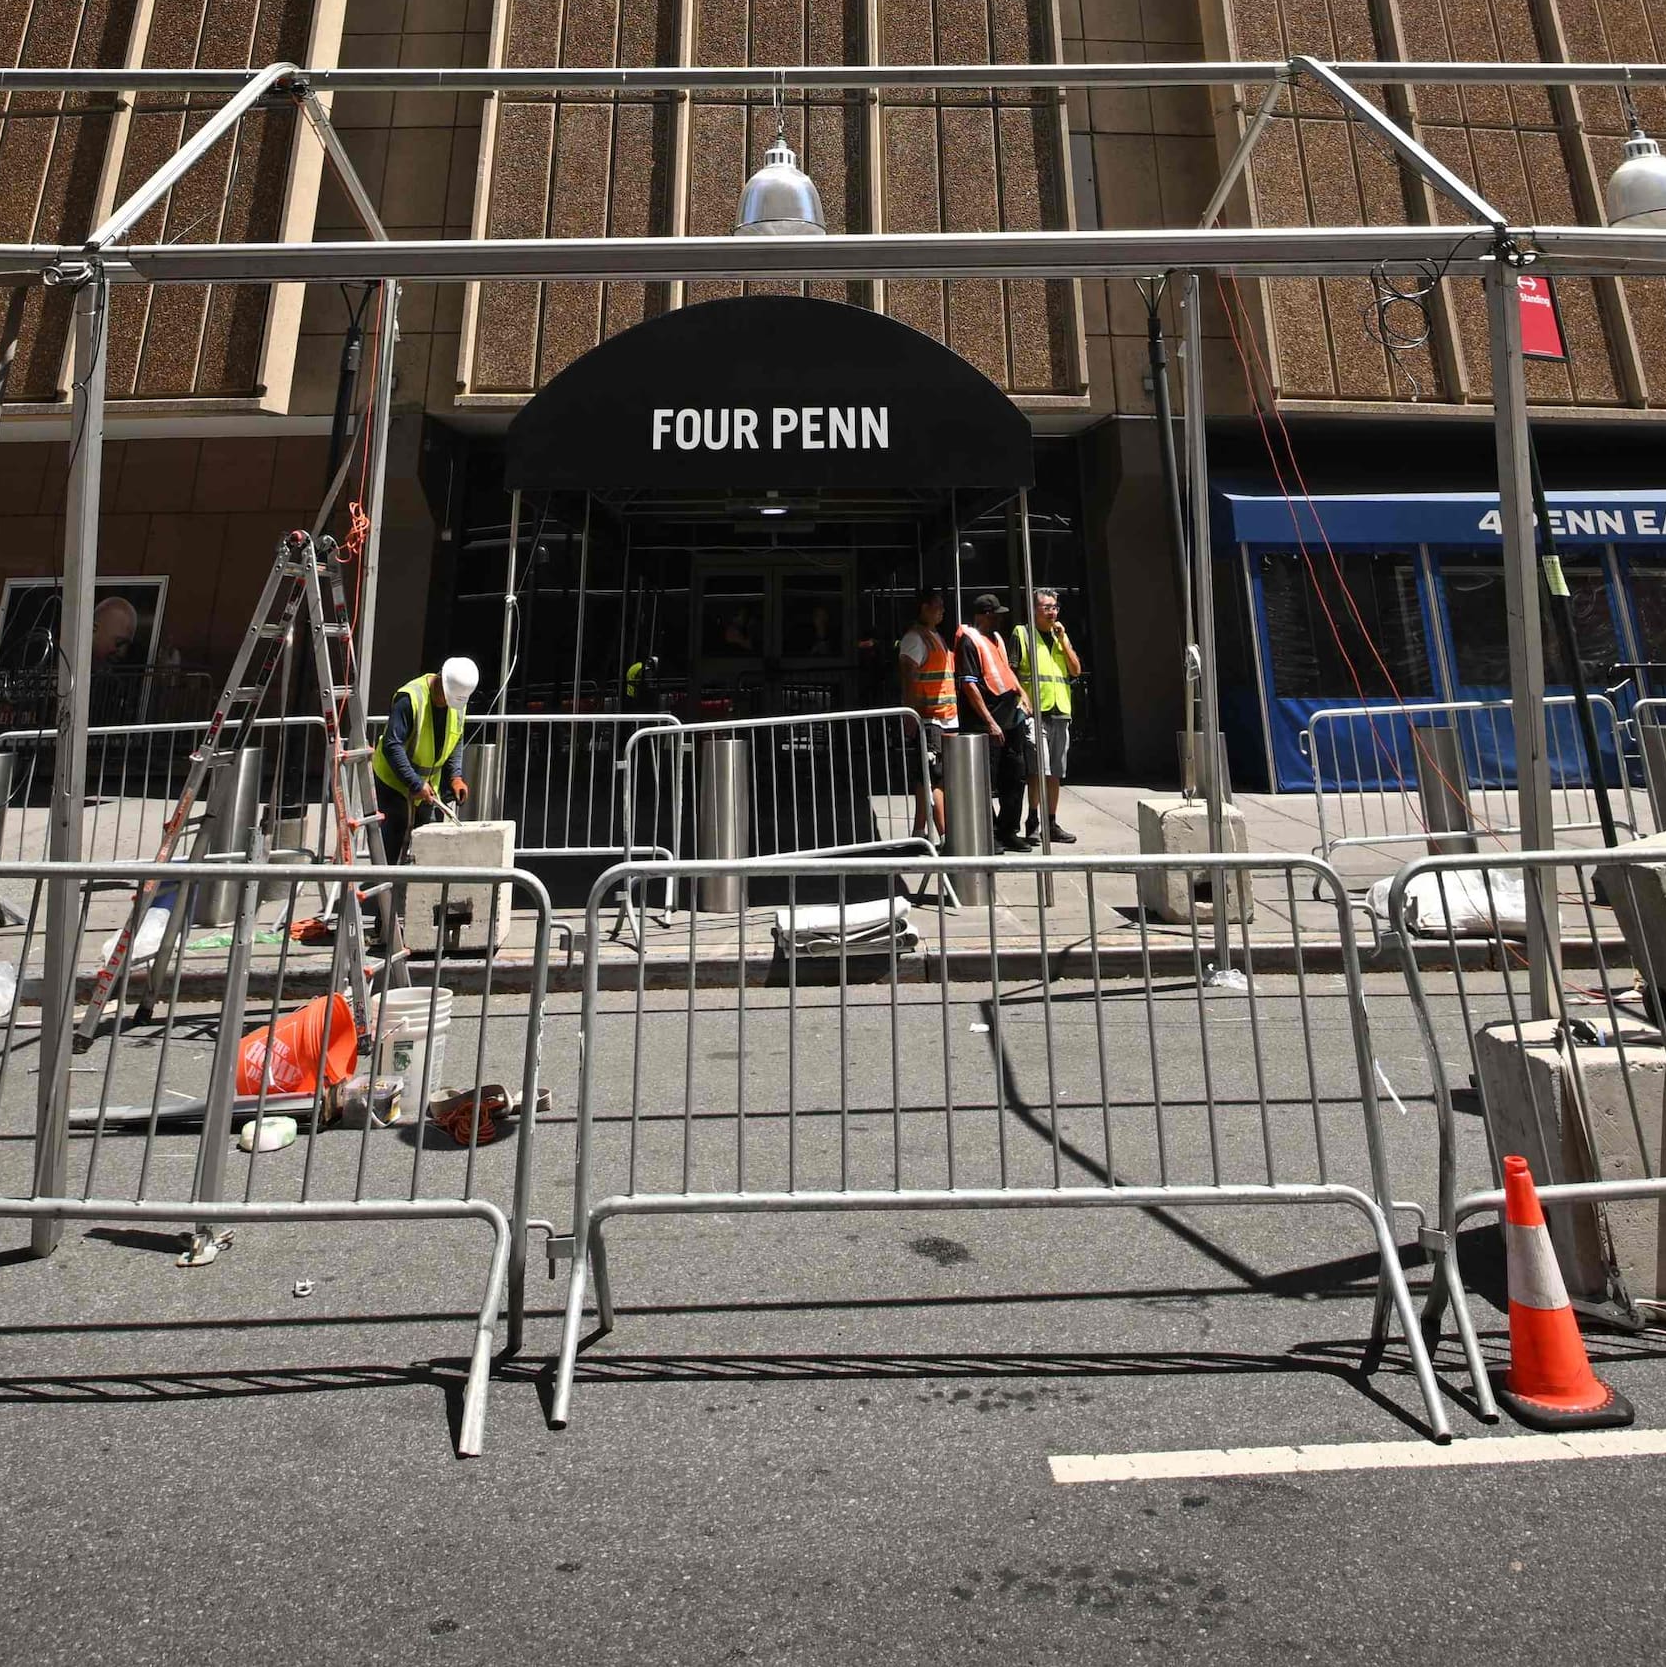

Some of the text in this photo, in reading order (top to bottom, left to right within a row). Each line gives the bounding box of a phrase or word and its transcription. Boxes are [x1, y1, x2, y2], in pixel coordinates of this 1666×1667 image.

[1519, 292, 1551, 308] Standing
[652, 406, 889, 450] FOUR PENN
[1478, 509, 1502, 535] 4
[1533, 509, 1627, 535] ENN
